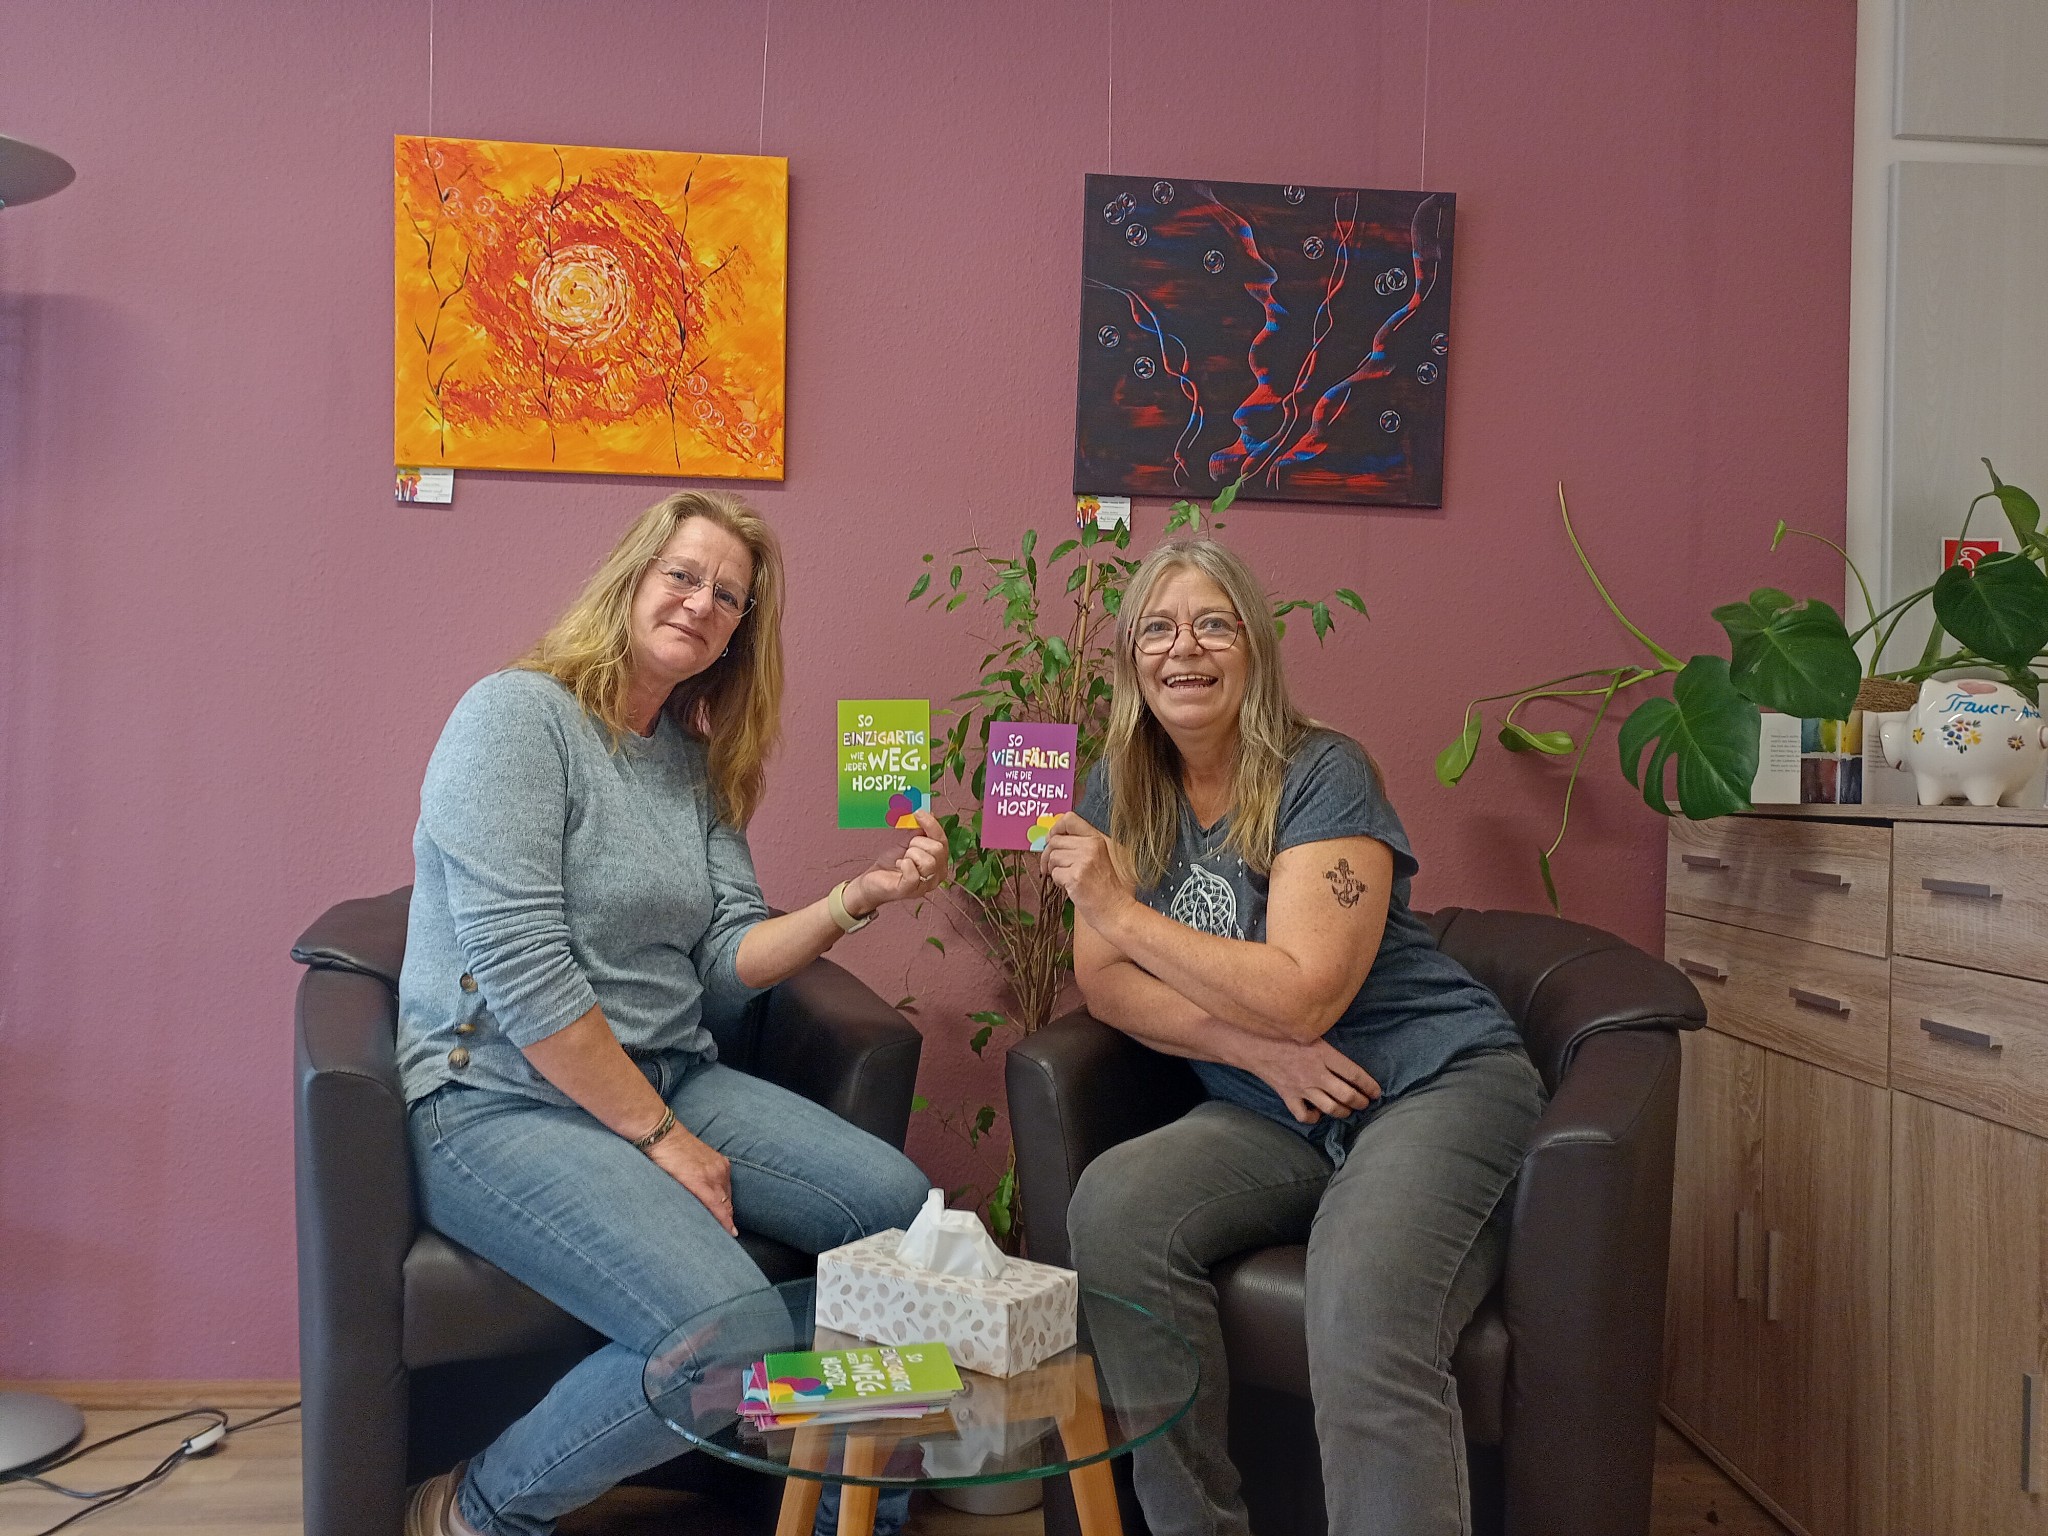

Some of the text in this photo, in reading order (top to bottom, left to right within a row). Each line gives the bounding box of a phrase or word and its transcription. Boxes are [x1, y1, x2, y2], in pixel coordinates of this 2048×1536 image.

[1939, 693, 2016, 715] Trauer-
[857, 714, 874, 728] SO
[1007, 733, 1023, 747] SO
[850, 751, 865, 760] WIE
[867, 747, 928, 772] WEG.
[844, 762, 867, 772] JEDER
[1005, 770, 1033, 780] WIE DIE
[990, 780, 1068, 799] MENSCHEN.
[851, 1362, 887, 1396] WEG.
